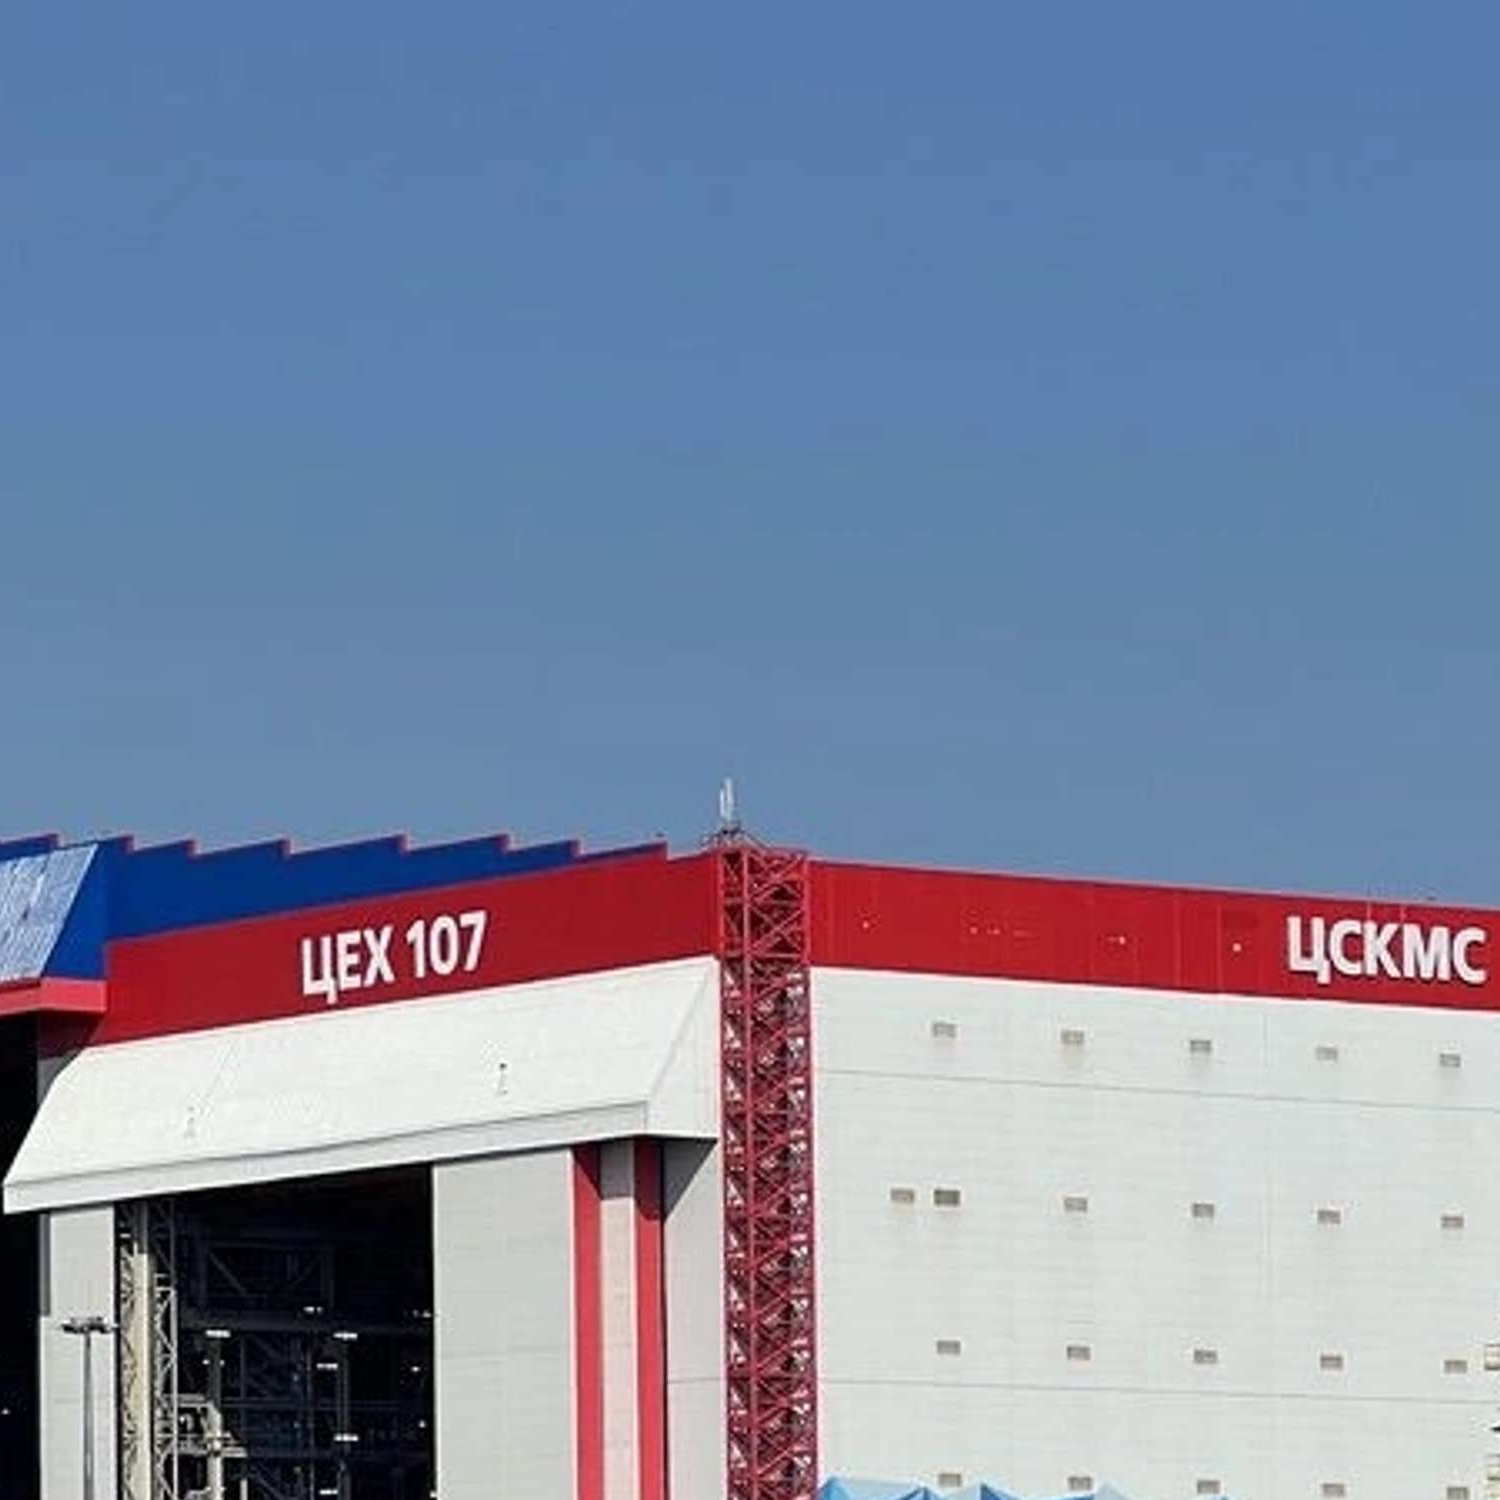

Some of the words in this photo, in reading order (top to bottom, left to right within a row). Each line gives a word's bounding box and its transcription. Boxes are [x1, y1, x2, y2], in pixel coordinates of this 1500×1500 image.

[302, 926, 395, 1004] ЦЕХ
[405, 911, 488, 979] 107
[1286, 915, 1488, 985] ЦСКМС
